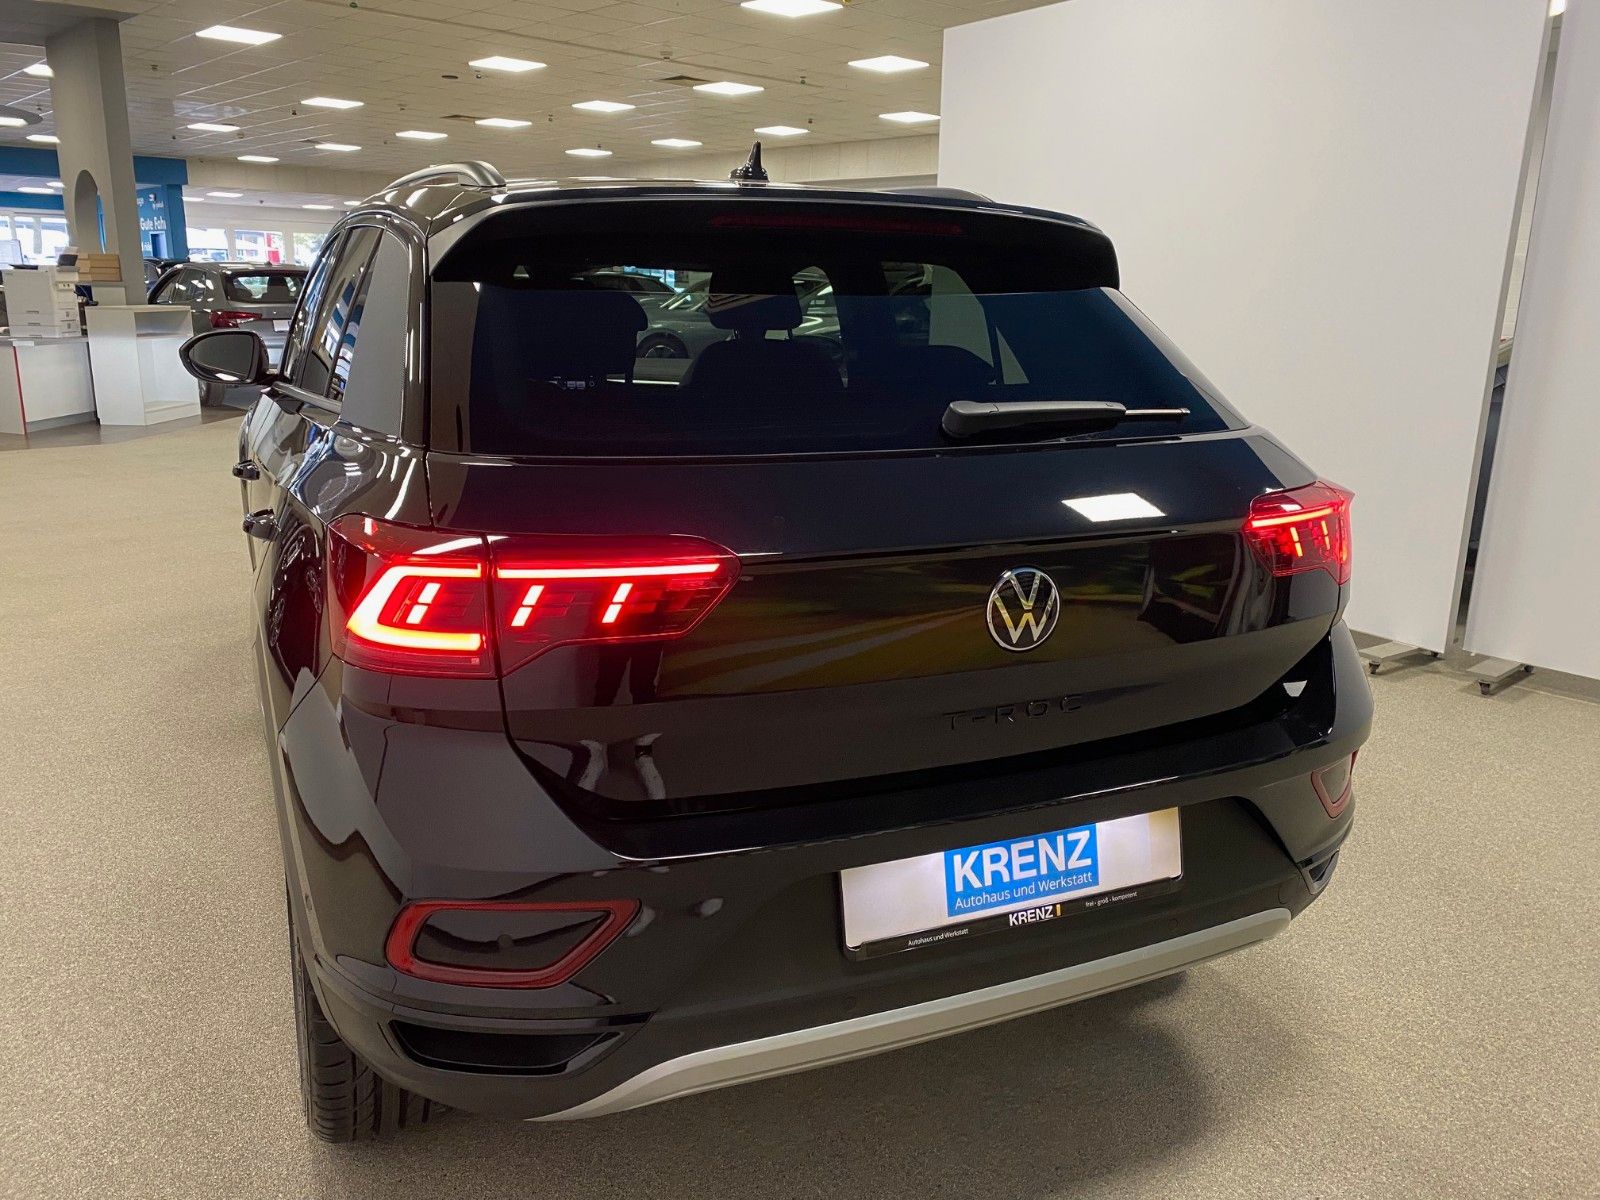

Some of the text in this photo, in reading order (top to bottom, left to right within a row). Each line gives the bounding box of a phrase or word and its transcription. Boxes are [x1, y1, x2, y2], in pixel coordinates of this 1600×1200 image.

[942, 693, 1083, 730] T-ROC
[953, 829, 1092, 893] KRENZ
[954, 871, 1093, 910] Autohaus und Werkstatt
[1008, 905, 1054, 927] KRENZ
[908, 928, 969, 947] Autohaus und Werkstatt
